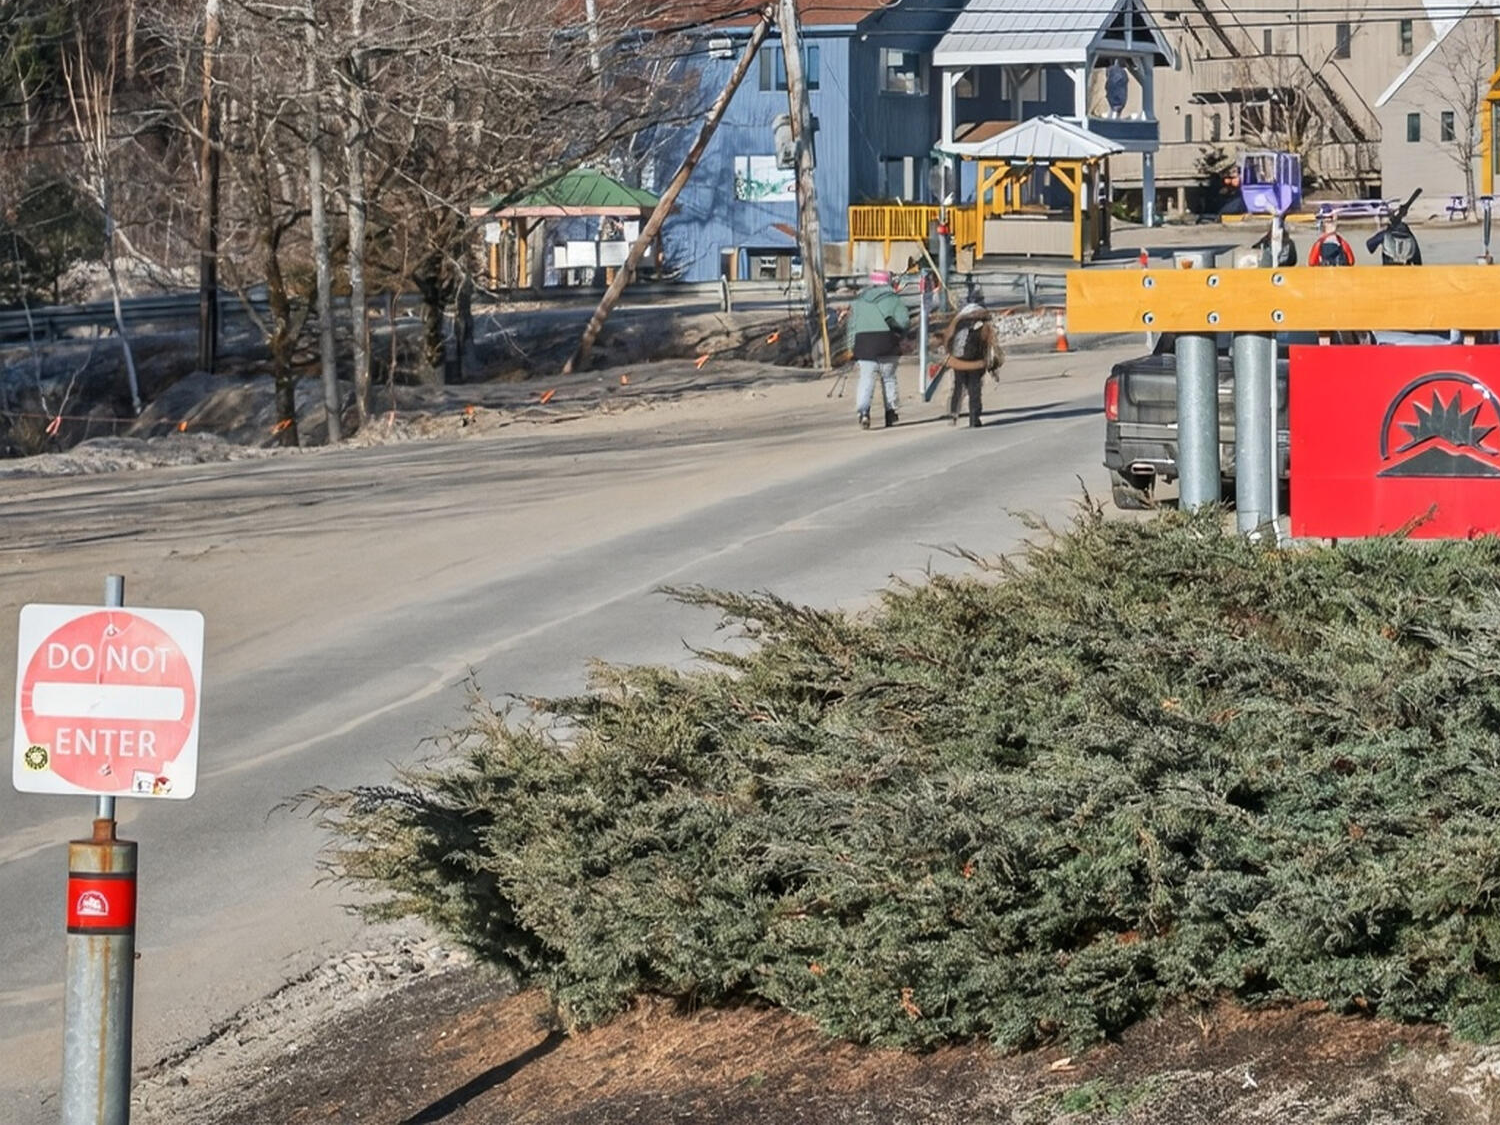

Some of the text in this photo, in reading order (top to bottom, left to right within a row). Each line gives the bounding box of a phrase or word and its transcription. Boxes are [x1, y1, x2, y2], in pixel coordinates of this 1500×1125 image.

[47, 642, 171, 674] DO NOT
[54, 727, 158, 759] ENTER
